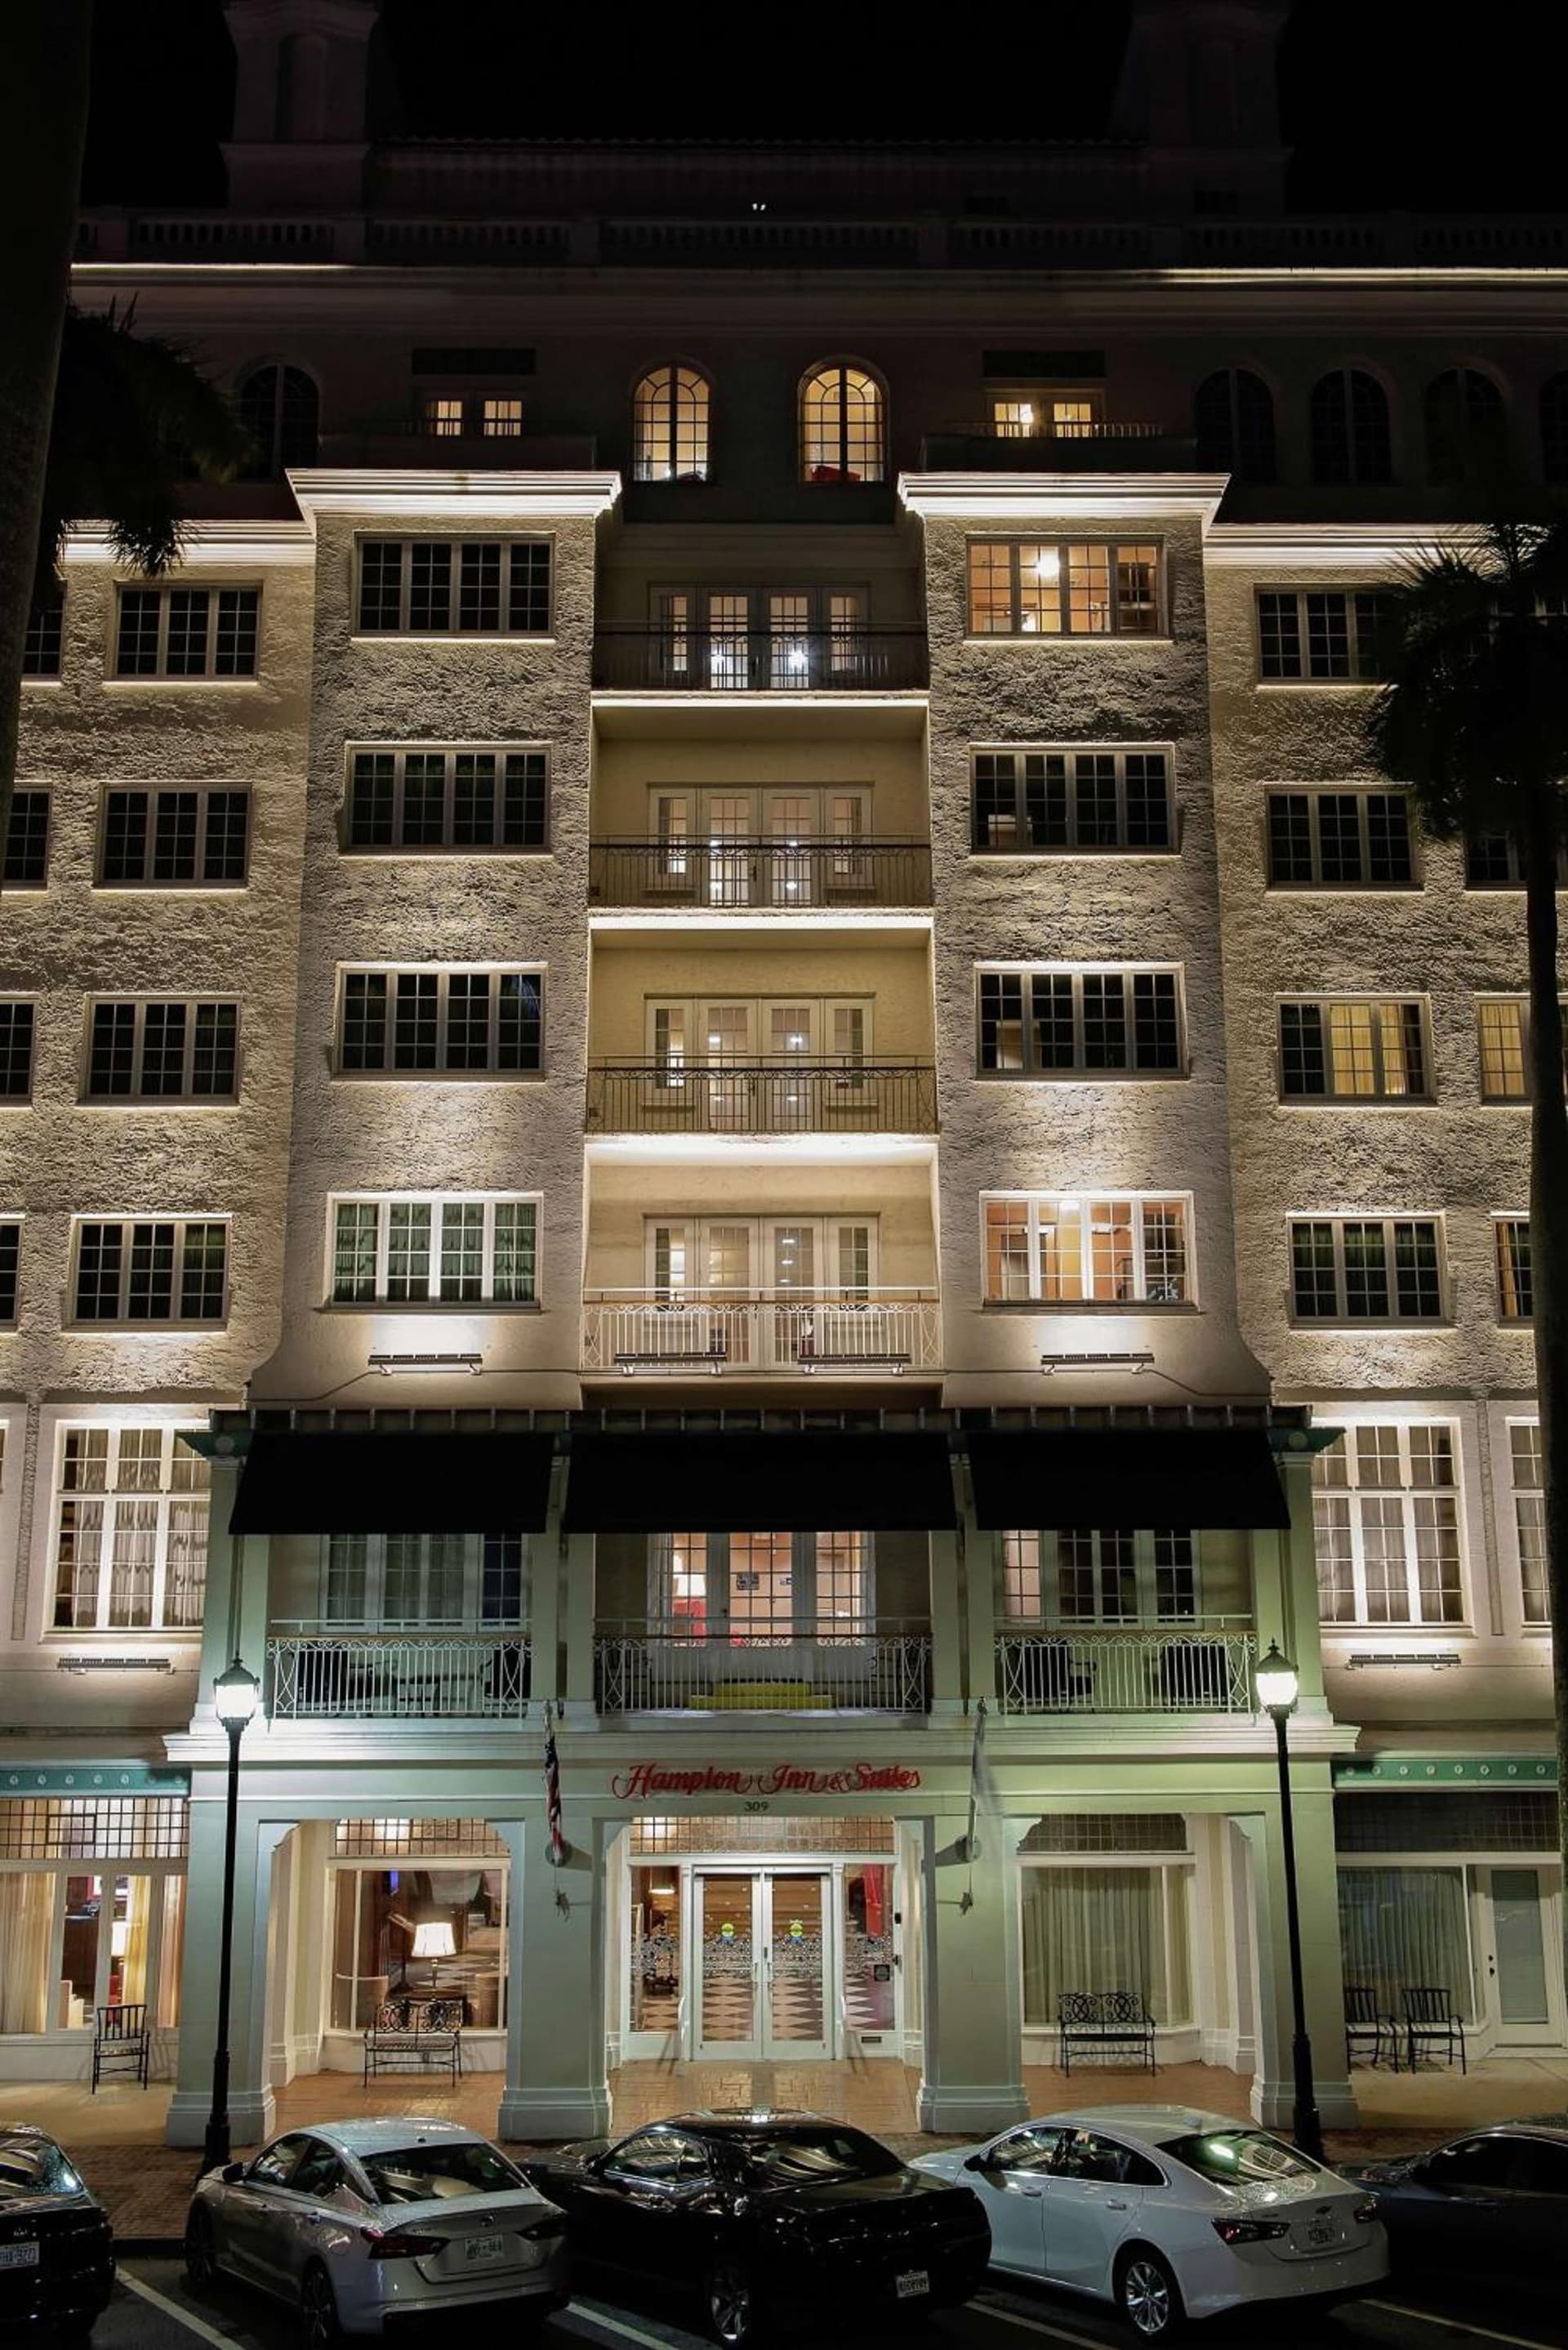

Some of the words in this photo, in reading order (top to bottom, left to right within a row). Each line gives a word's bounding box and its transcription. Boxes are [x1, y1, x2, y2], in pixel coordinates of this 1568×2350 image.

[612, 1762, 753, 1799] Hampton
[758, 1764, 826, 1795] Inn
[826, 1771, 847, 1792] &
[845, 1762, 920, 1791] Suites
[744, 1801, 768, 1812] 309
